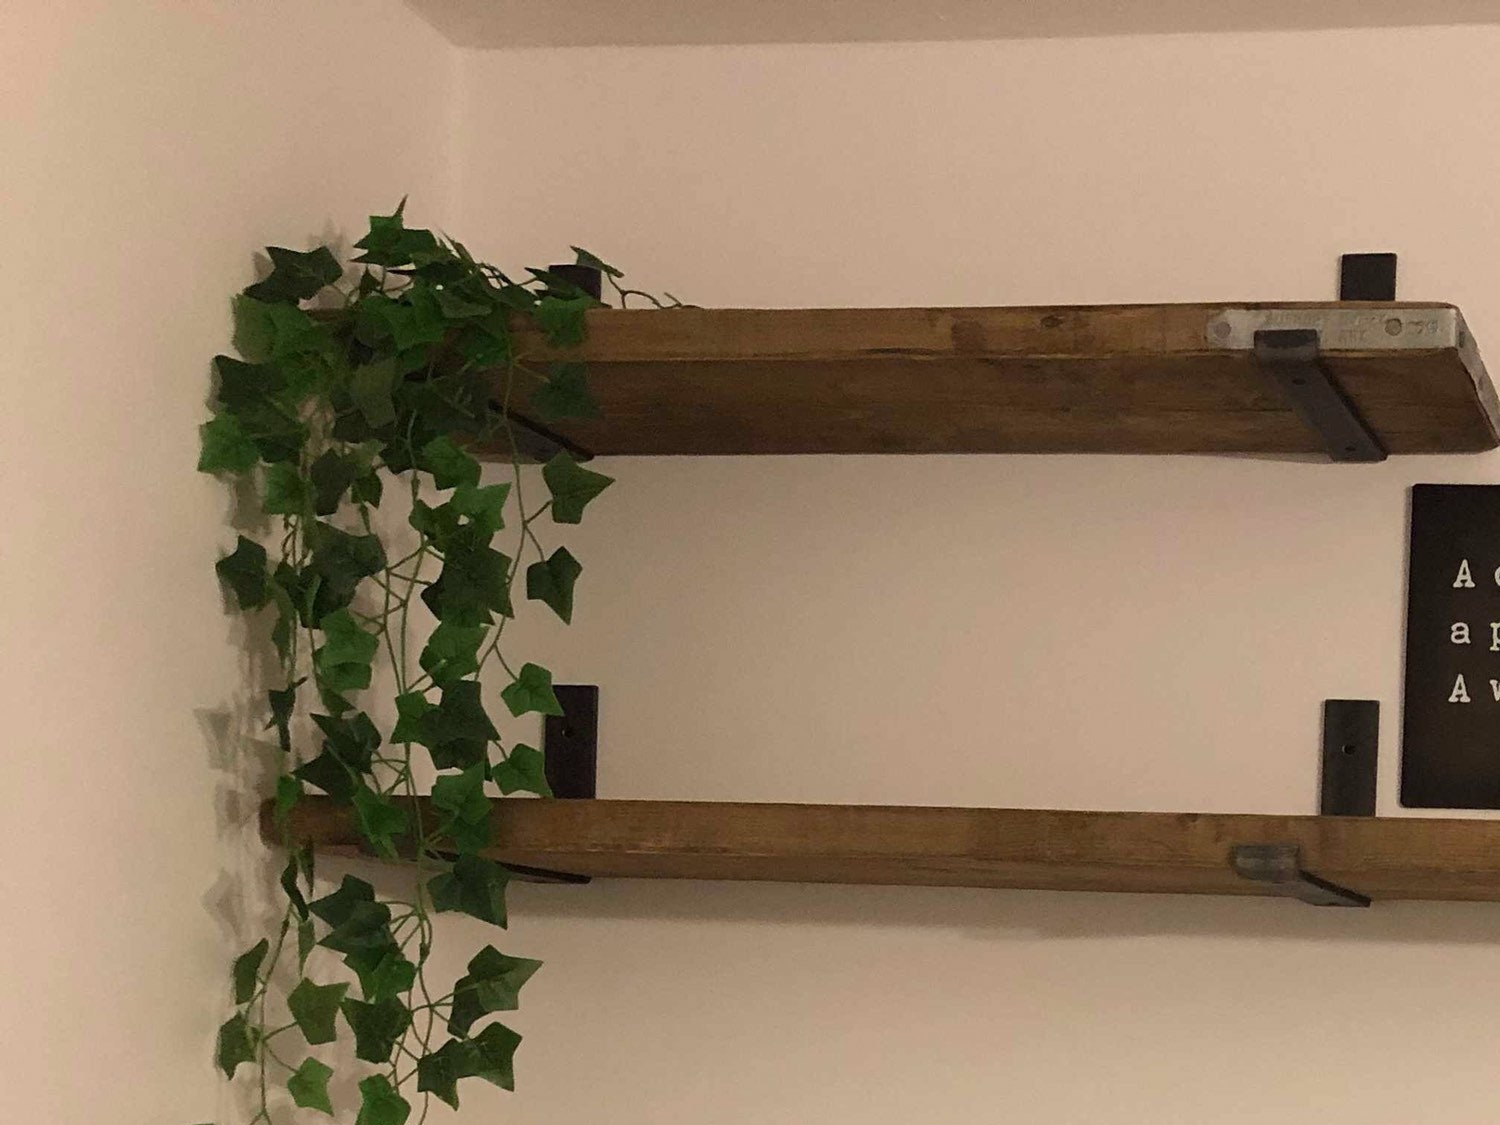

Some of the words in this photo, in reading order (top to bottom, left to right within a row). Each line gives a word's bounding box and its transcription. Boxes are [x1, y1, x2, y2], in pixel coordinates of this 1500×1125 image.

[1453, 559, 1476, 588] A
[1450, 621, 1470, 644] a
[1448, 674, 1470, 703] A
